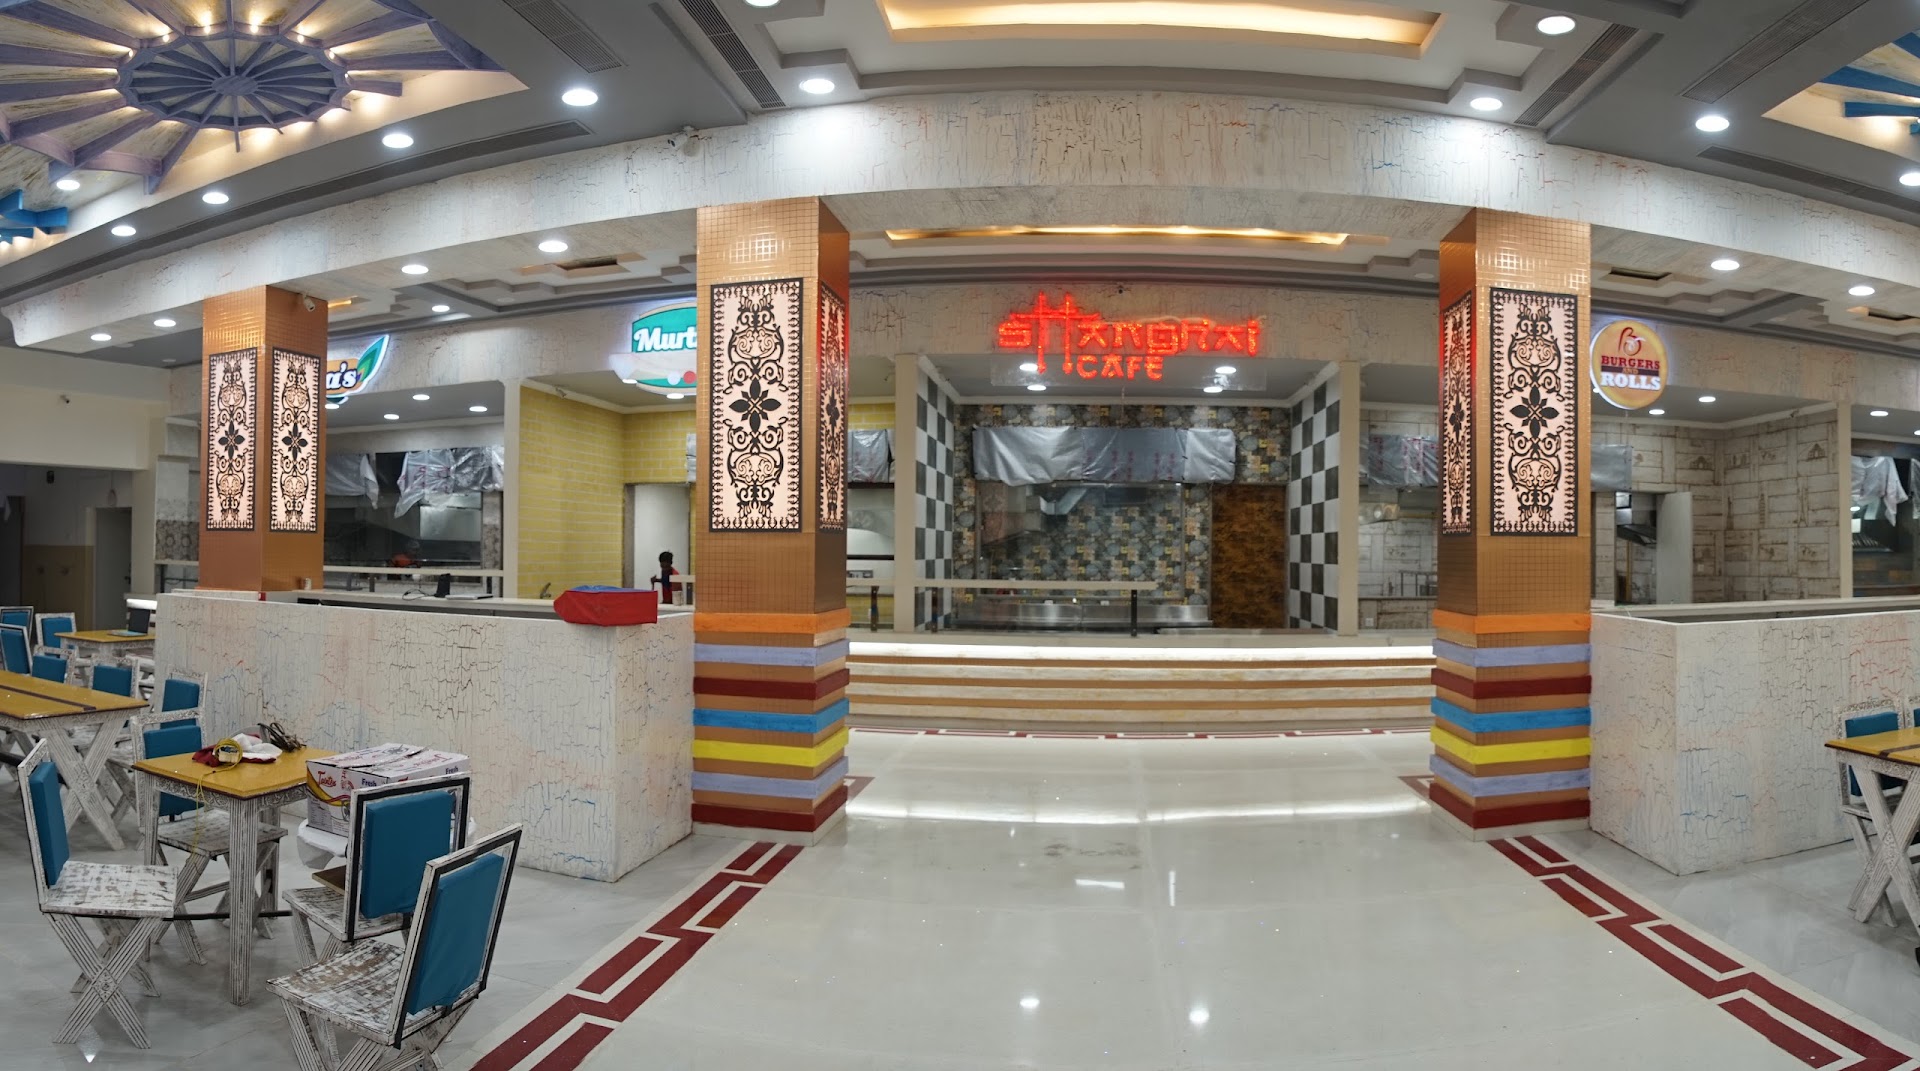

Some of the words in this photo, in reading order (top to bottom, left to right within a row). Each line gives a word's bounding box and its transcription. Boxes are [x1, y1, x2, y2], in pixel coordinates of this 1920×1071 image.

[1076, 354, 1163, 379] CAFE
[1601, 355, 1660, 370] BURGERS
[1600, 371, 1661, 391] ROLLS
[361, 778, 377, 787] Fresh
